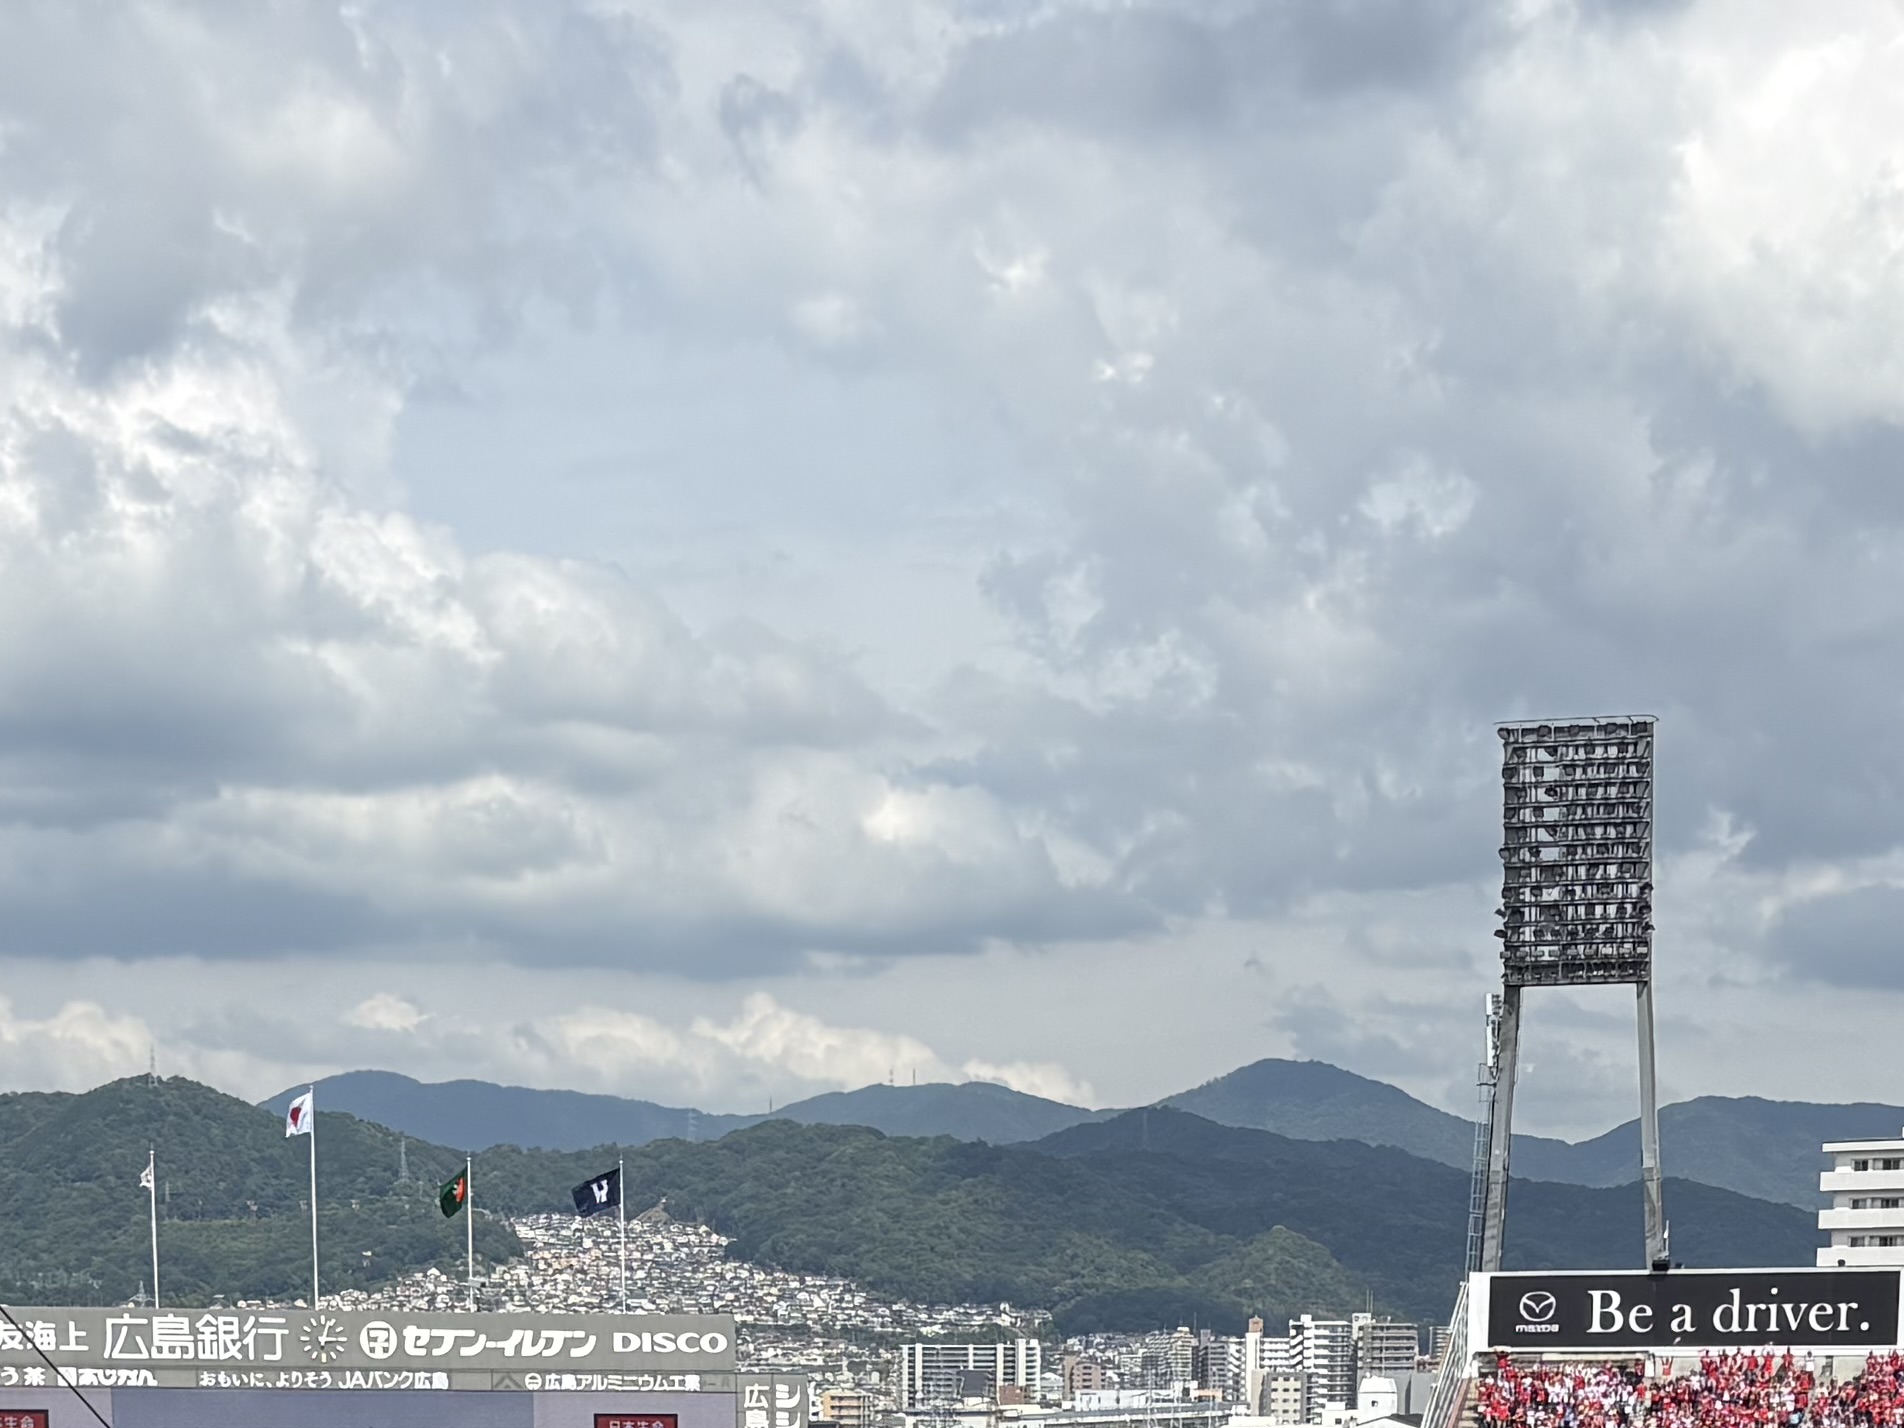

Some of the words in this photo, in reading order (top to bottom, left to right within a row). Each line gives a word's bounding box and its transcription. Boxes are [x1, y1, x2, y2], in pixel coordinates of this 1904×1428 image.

[1586, 1289, 1653, 1333] Be
[1671, 1303, 1696, 1333] a
[1713, 1286, 1871, 1333] driver.
[103, 1313, 289, 1361] 広島銀行
[613, 1331, 729, 1354] DISCO
